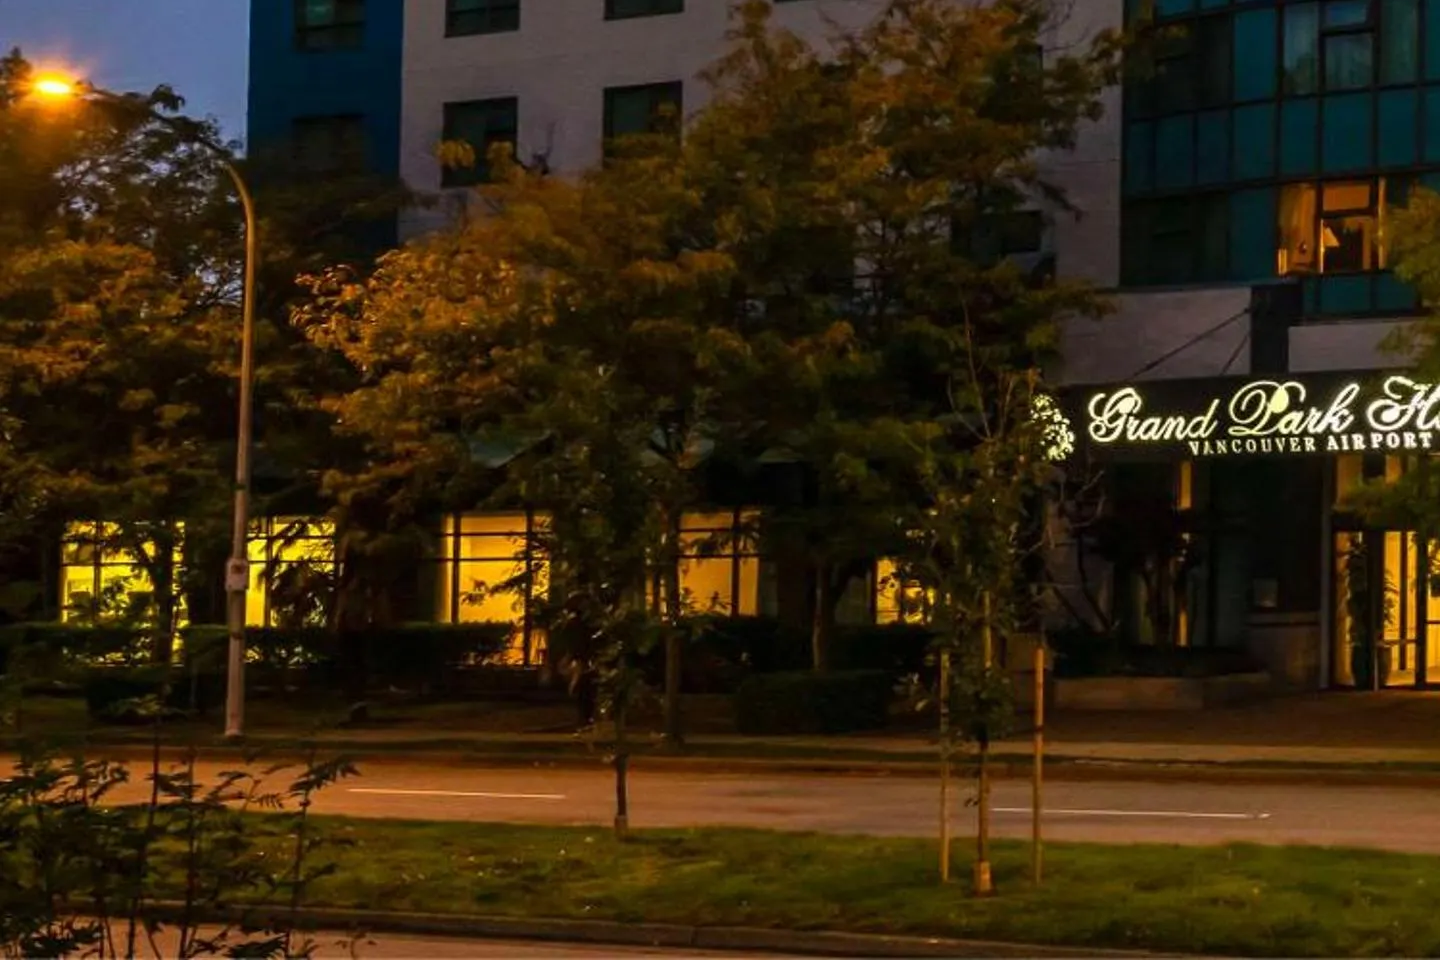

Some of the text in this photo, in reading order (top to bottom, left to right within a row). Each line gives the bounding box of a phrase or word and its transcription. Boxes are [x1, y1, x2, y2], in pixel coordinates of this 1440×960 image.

[1088, 386, 1219, 442] Grand
[1228, 381, 1361, 438] Park
[1189, 431, 1434, 456] VANCOUVER AIRPORT
